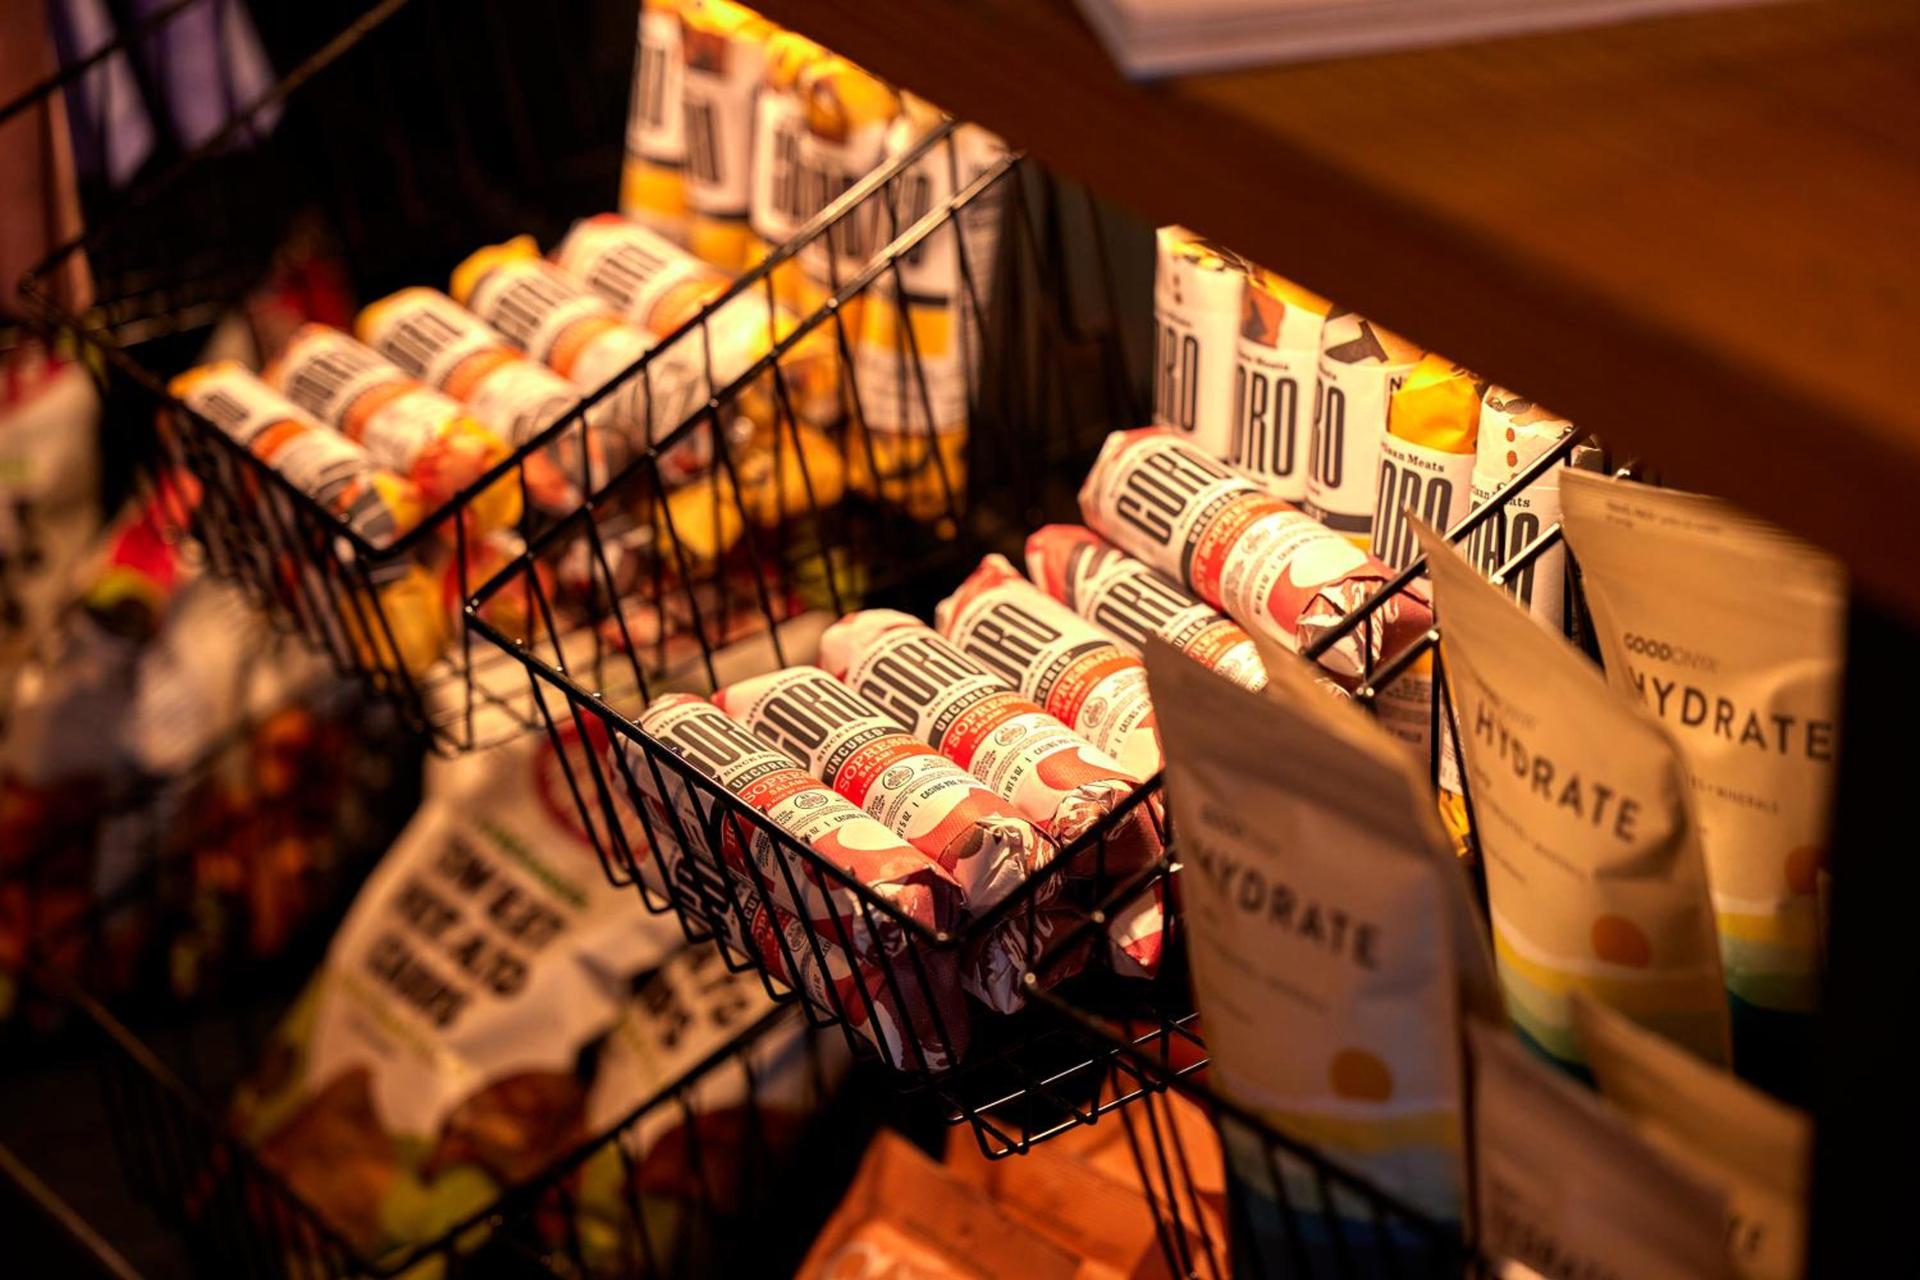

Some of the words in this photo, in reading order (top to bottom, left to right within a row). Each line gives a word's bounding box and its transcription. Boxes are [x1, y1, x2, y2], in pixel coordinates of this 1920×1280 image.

[1407, 452, 1445, 473] Meats
[859, 636, 987, 732] CORO
[752, 677, 878, 771] CORO
[813, 729, 844, 760] SINCE
[722, 756, 756, 777] SINCE
[857, 748, 895, 778] SALAMI
[1474, 702, 1641, 844] HYDRATE
[920, 782, 945, 799] CASING
